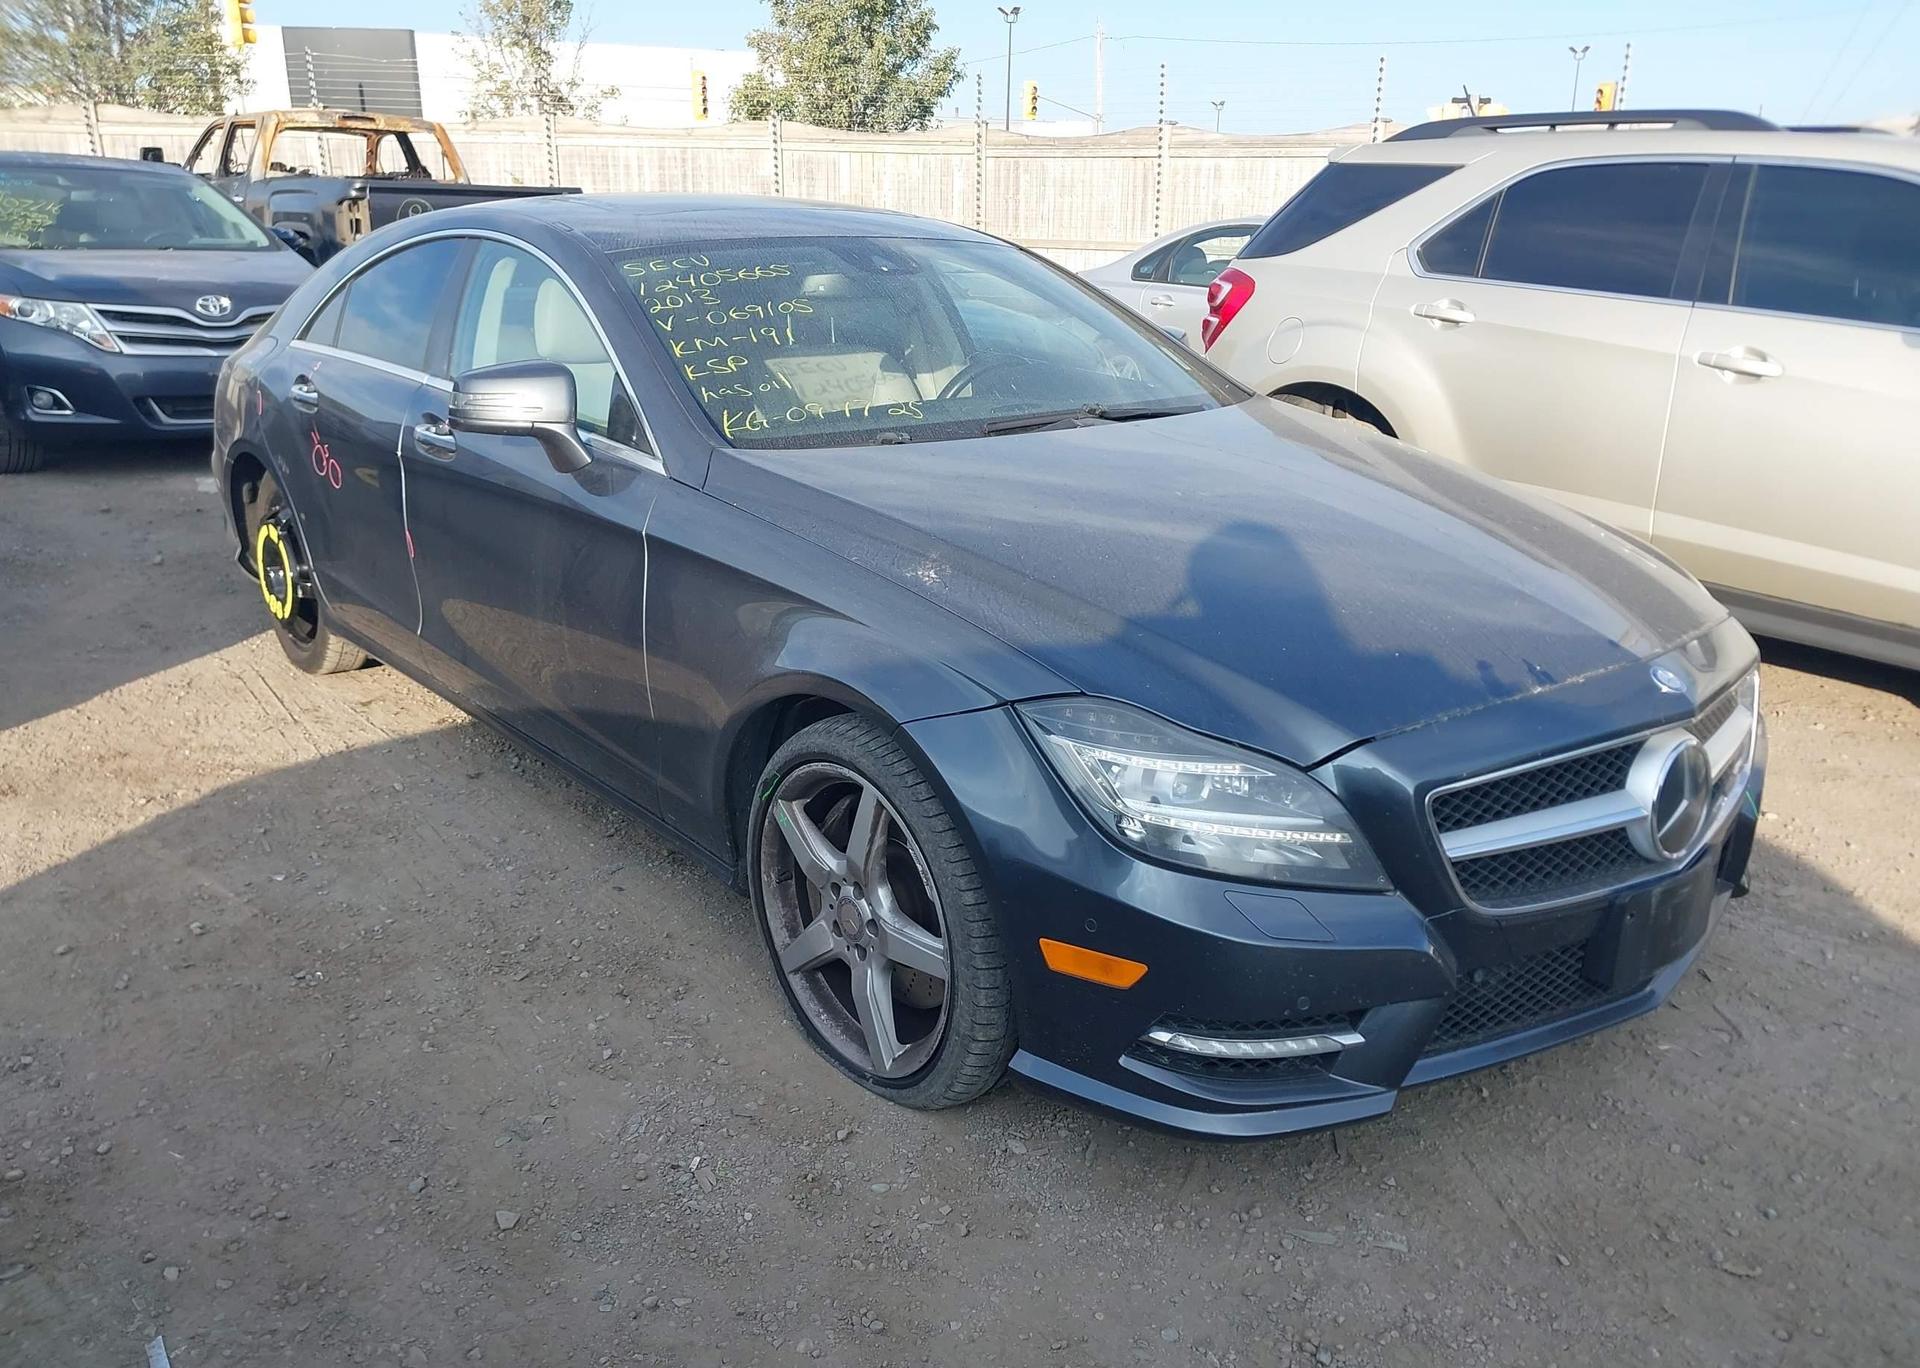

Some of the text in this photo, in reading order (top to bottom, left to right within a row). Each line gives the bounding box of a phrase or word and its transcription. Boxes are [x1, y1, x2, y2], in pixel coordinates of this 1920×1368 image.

[640, 264, 791, 296] 12405665
[644, 288, 721, 314] 2013
[684, 355, 748, 380] KSP
